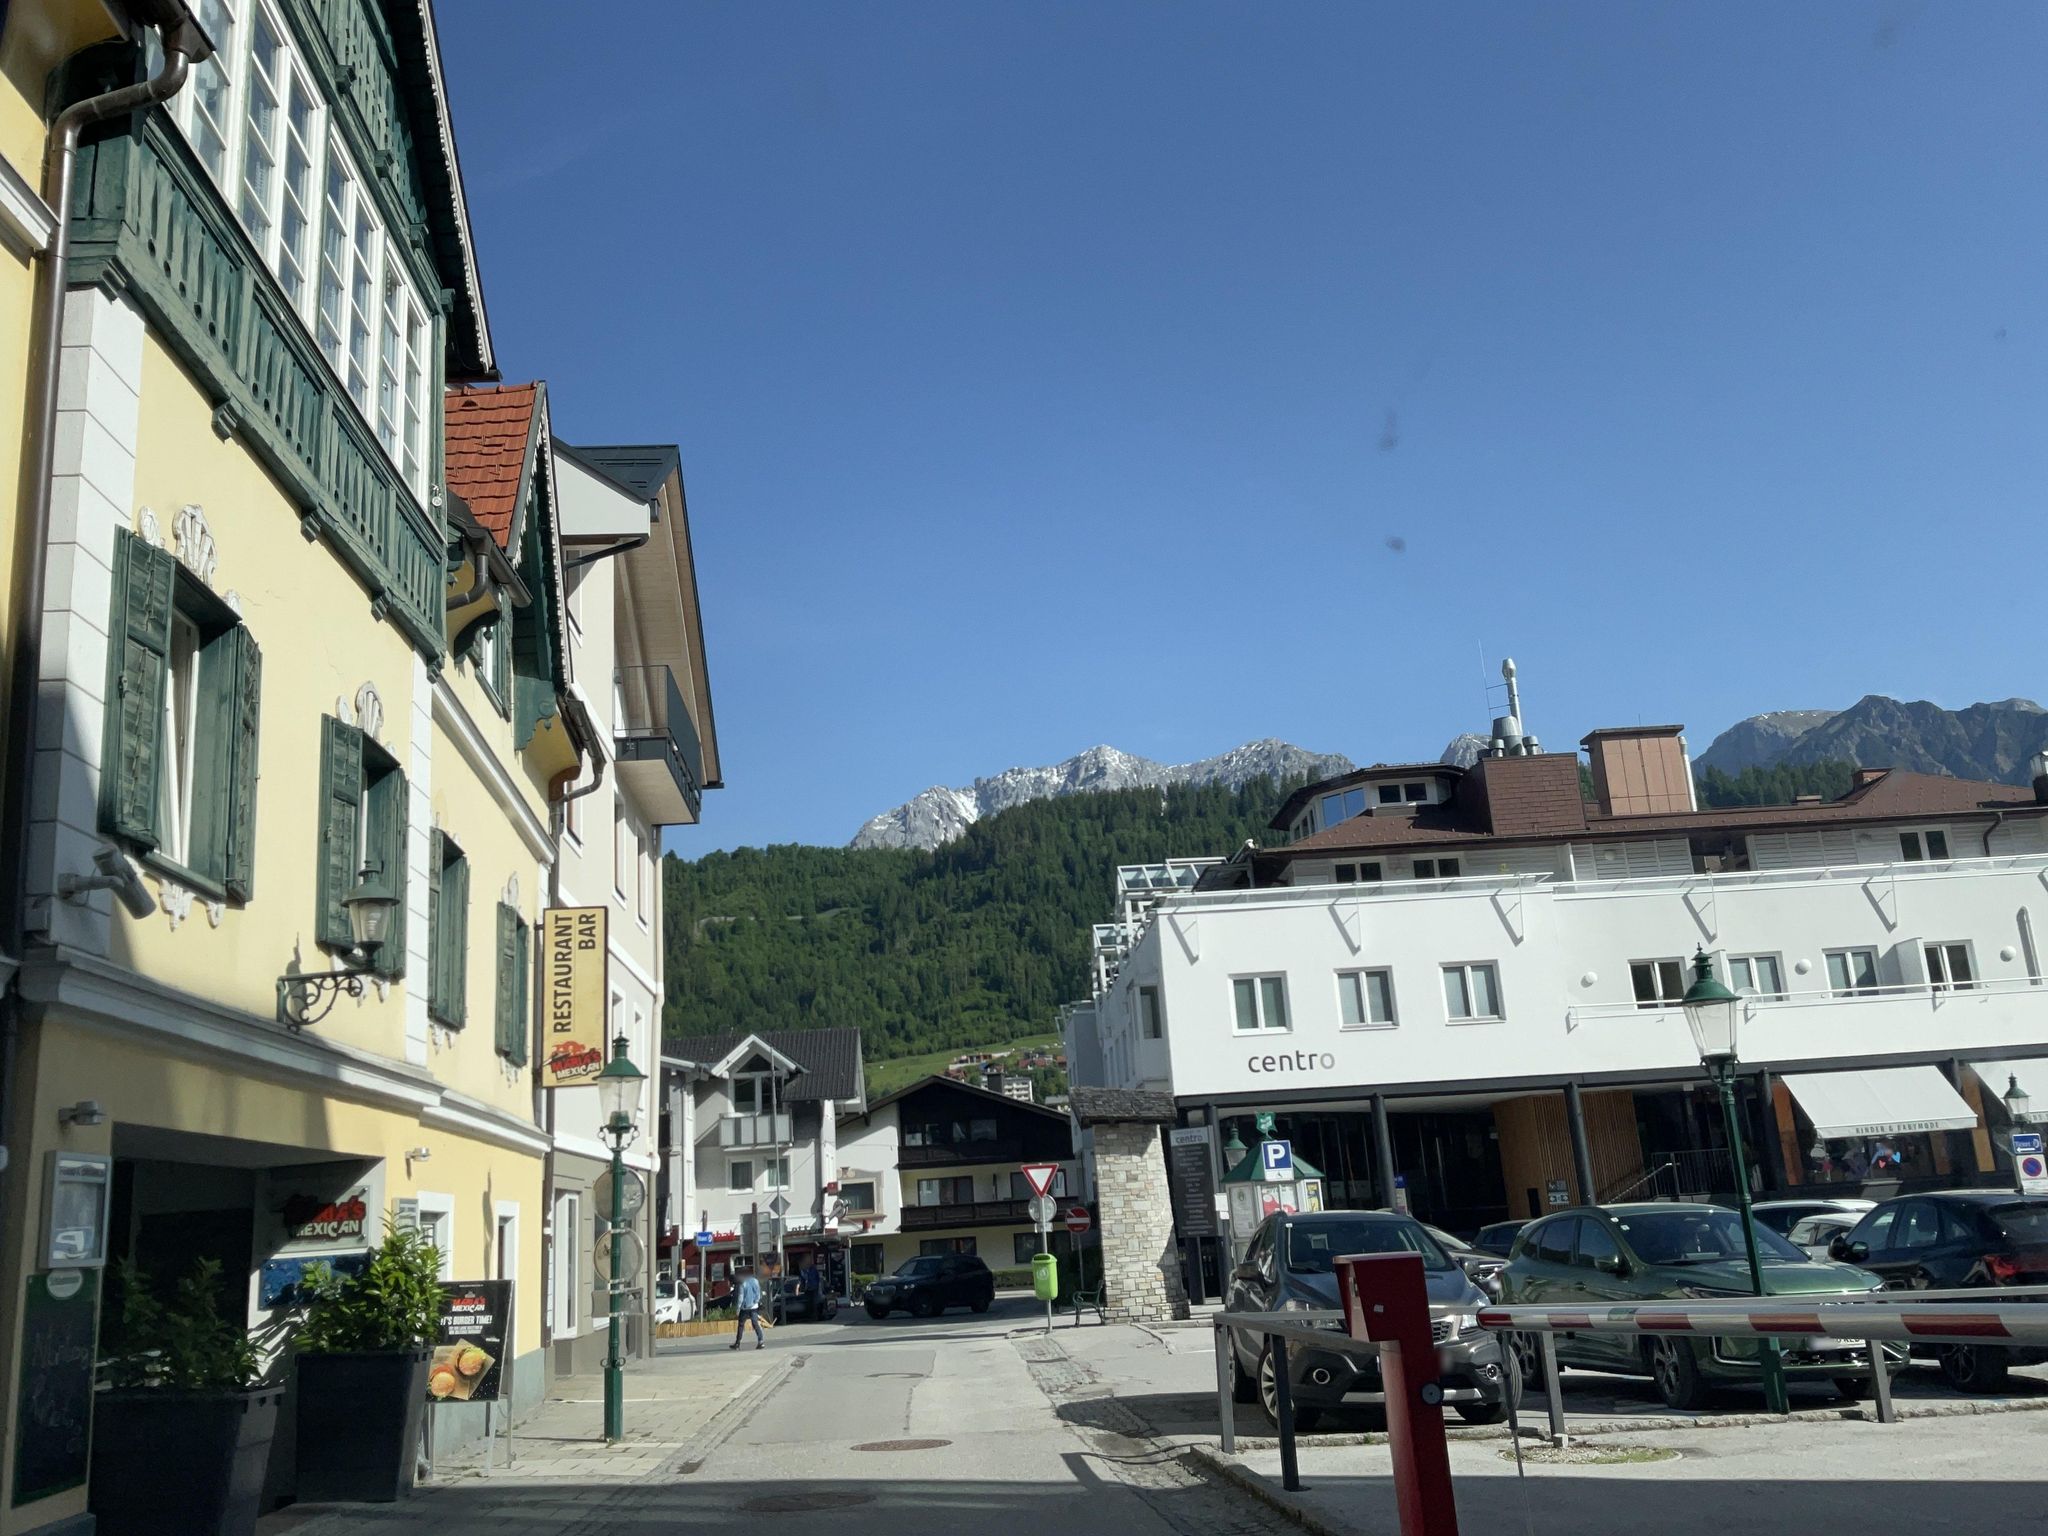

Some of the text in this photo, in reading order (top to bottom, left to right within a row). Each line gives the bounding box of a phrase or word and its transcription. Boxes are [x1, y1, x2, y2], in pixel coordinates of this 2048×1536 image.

[578, 913, 596, 950] BAR
[553, 914, 573, 1033] RESTAURANT
[1248, 1050, 1335, 1073] centro
[556, 1062, 600, 1080] MEXICAN
[1856, 1125, 1885, 1134] KINDER
[1897, 1121, 1939, 1131] BABYMODE
[1175, 1134, 1203, 1144] centro
[1267, 1144, 1286, 1167] P
[452, 1304, 485, 1312] MEXICAN
[453, 1315, 475, 1325] BURGER
[476, 1315, 492, 1324] TIME!
